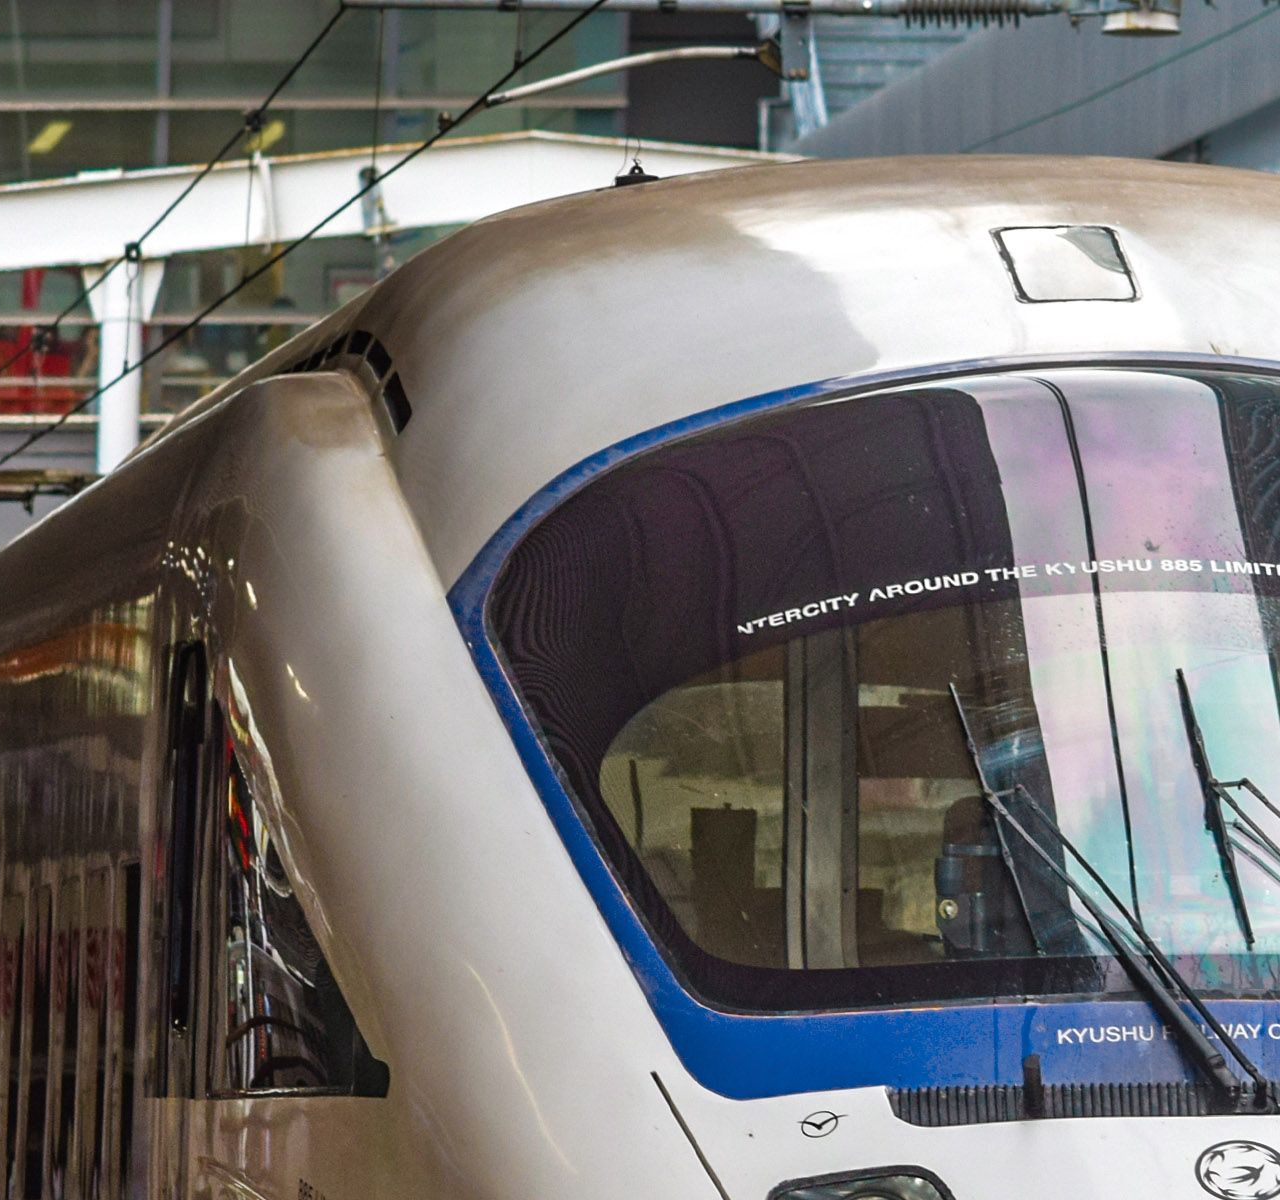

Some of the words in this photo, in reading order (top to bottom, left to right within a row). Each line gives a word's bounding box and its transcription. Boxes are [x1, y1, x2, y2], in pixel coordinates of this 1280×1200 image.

[869, 571, 980, 602] AROUND
[985, 565, 1036, 582] THE
[1045, 558, 1153, 577] KYUSHU
[1160, 558, 1203, 573] 885
[1057, 1026, 1154, 1044] KYUSHU
[1162, 1024, 1262, 1042] RLWAY
